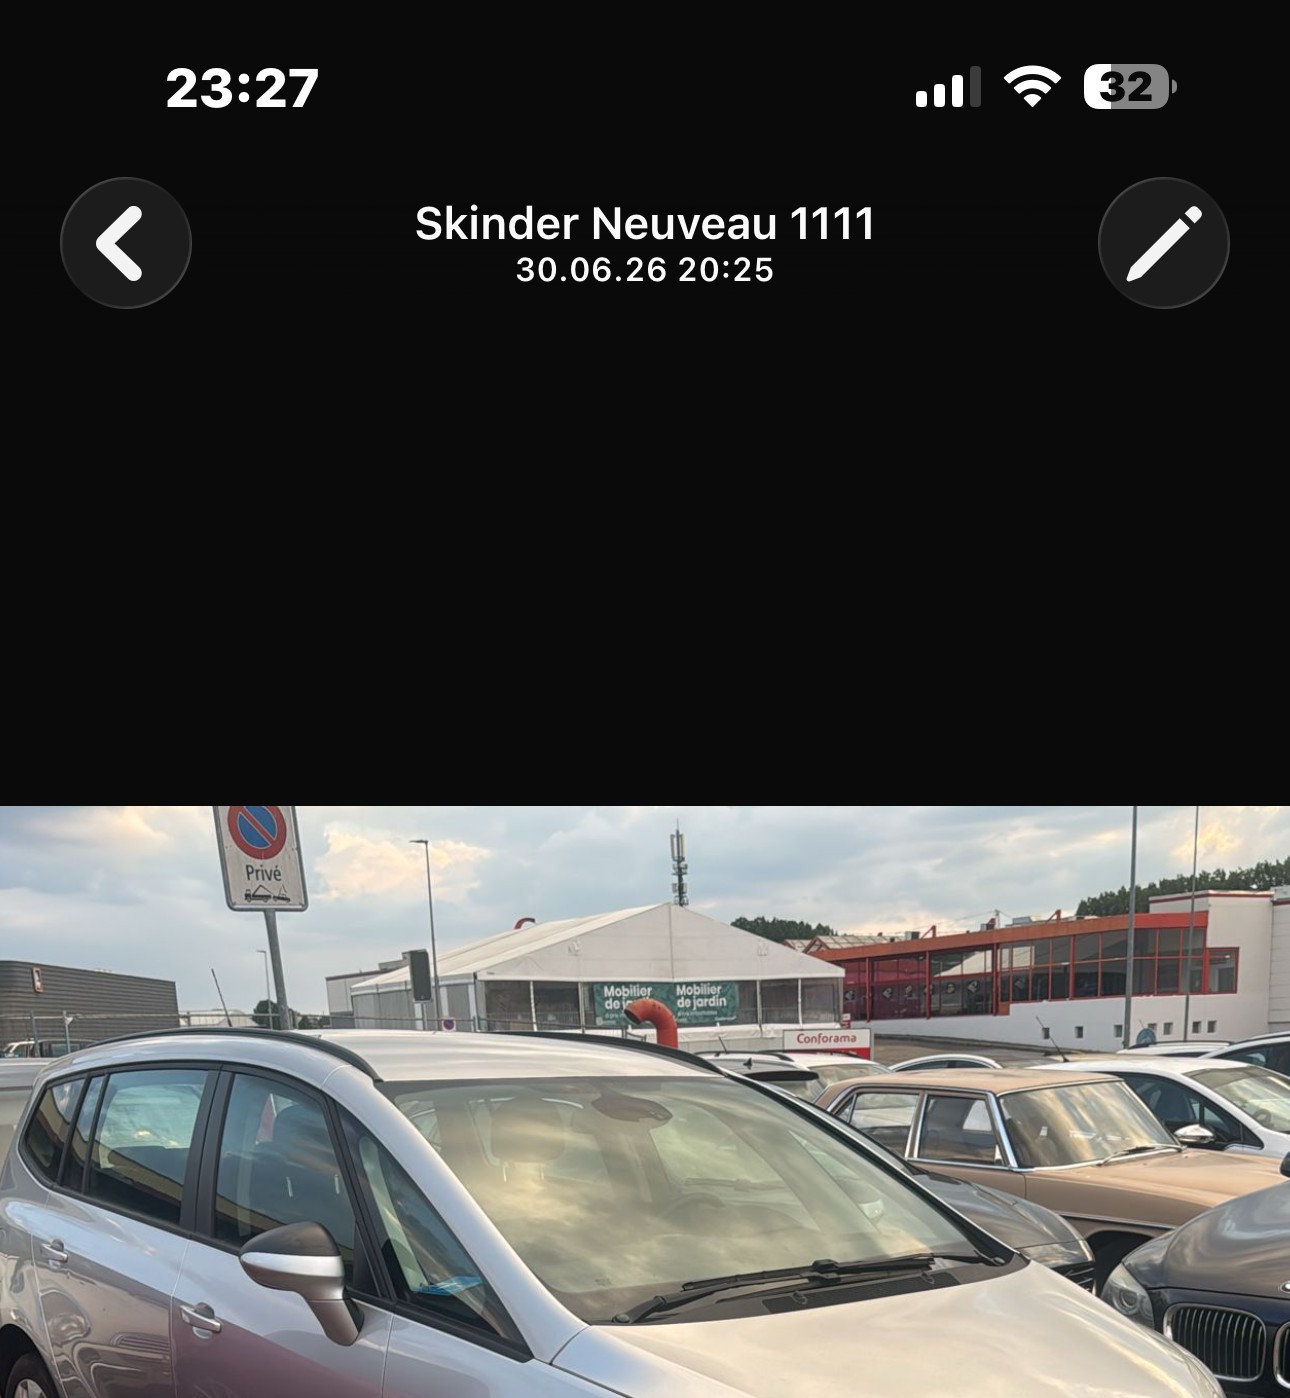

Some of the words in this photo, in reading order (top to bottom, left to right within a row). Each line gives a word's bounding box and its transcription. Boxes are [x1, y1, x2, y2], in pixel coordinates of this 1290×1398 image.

[245, 864, 282, 881] Privé
[603, 984, 652, 997] Mobilier
[676, 983, 722, 996] Mobilier
[604, 998, 620, 1010] de
[677, 996, 691, 1008] de
[692, 995, 727, 1011] jardin
[796, 1033, 857, 1045] Conforama
